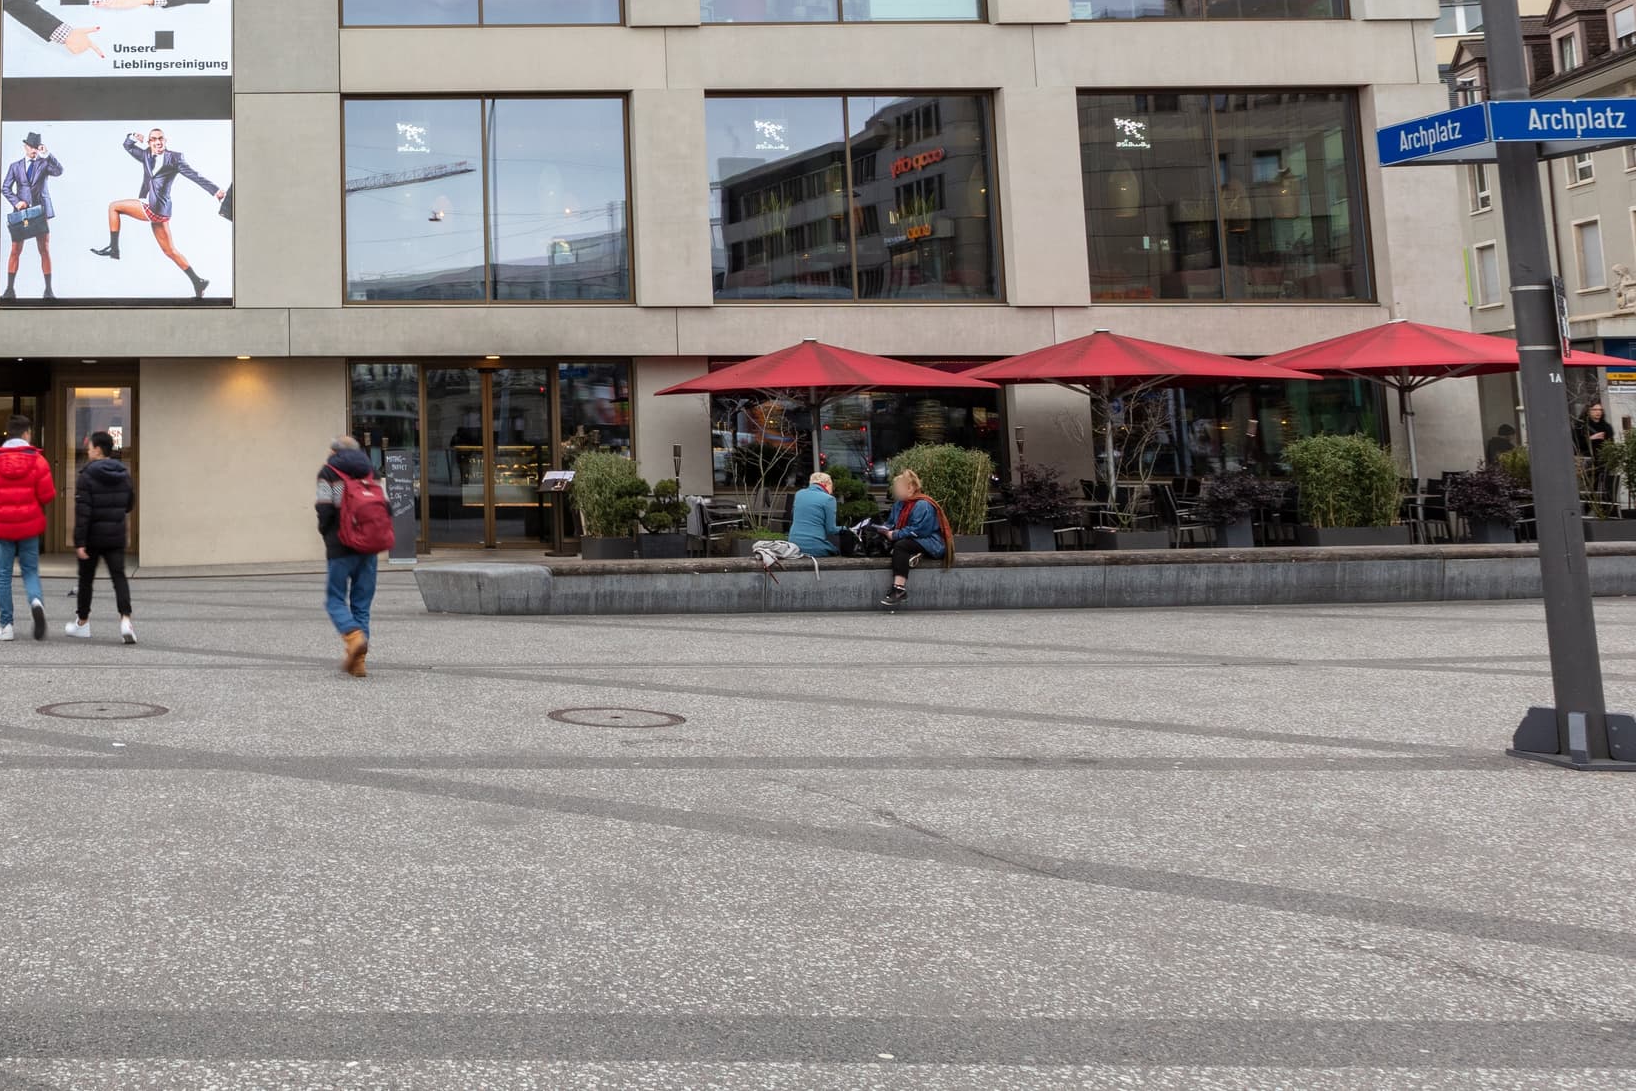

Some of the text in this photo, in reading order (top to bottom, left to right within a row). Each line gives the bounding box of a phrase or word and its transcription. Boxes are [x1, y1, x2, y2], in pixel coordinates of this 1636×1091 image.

[113, 43, 157, 53] Unsere
[113, 59, 228, 70] Lieblingsreinigung
[1527, 108, 1627, 135] Archplatz
[1399, 118, 1462, 153] Archplatz
[1549, 373, 1562, 383] 1A
